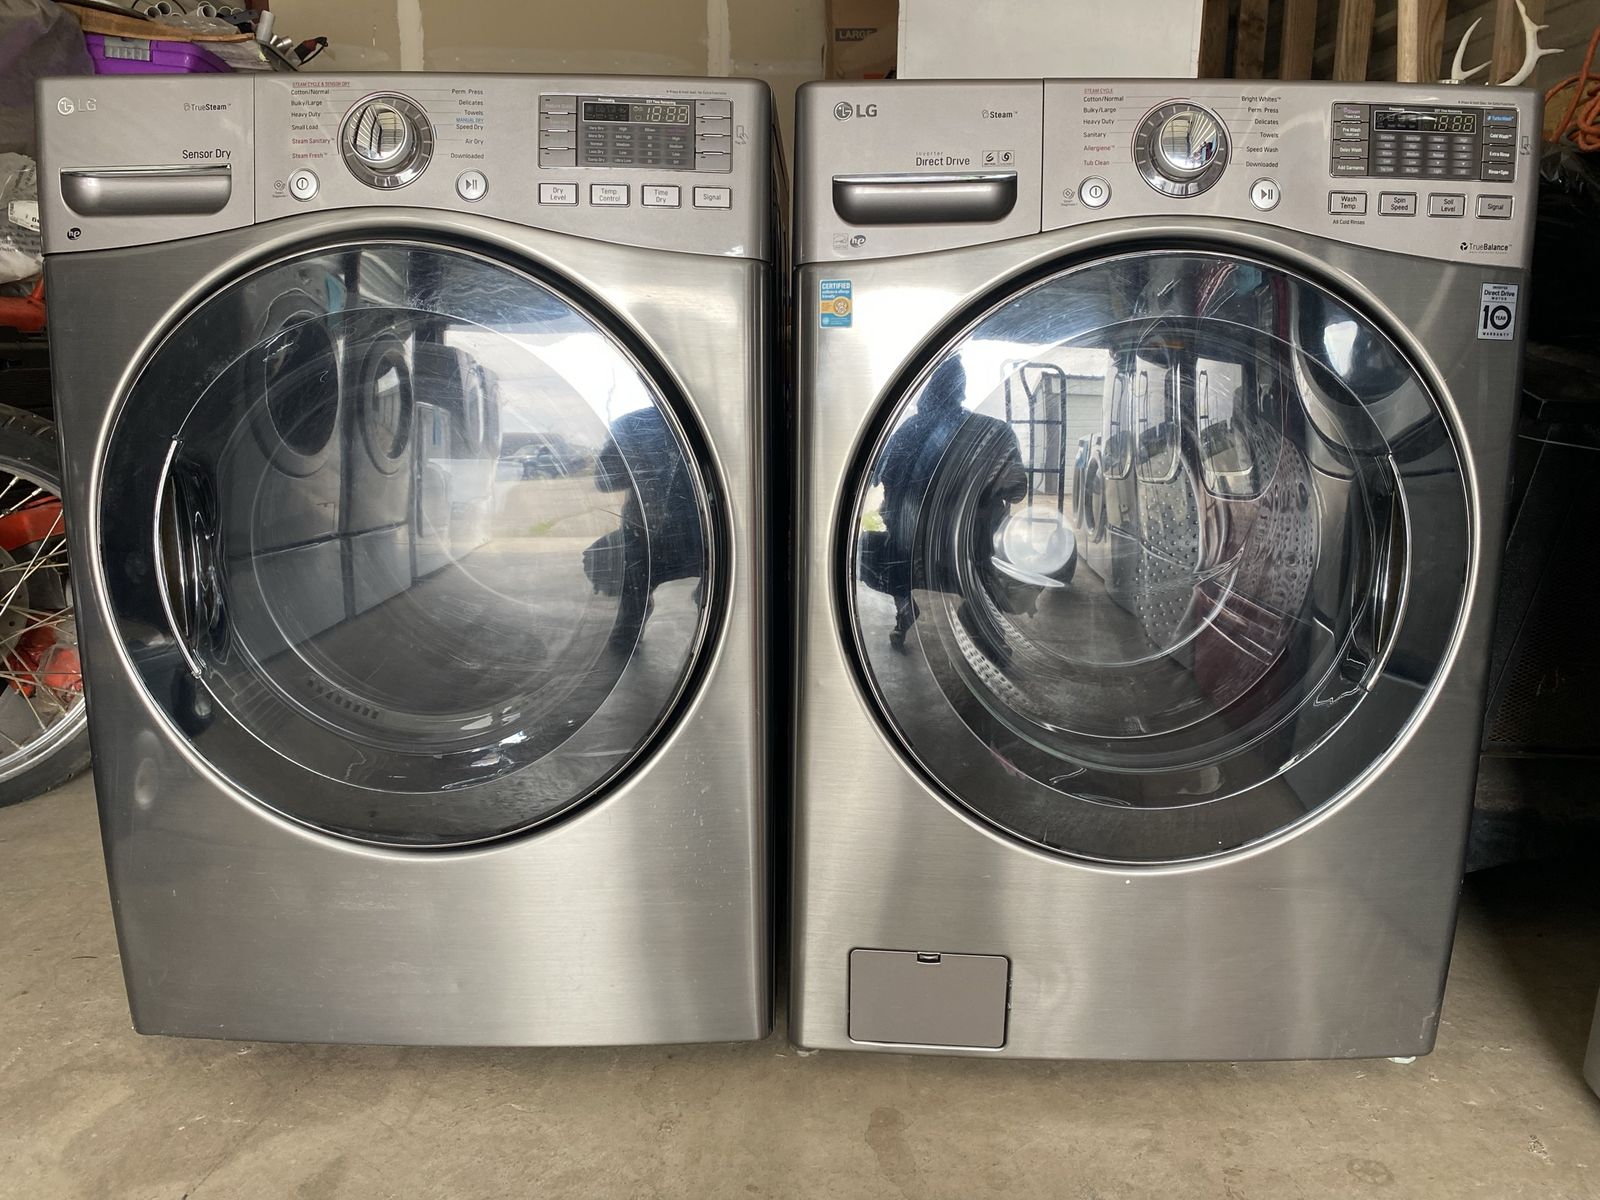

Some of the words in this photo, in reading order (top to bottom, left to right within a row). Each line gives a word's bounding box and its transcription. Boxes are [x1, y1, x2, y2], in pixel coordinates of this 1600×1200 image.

[290, 99, 323, 107] Bulky/Large
[1241, 95, 1259, 103] Bright
[77, 97, 98, 112] LG
[855, 103, 878, 118] LG
[1083, 106, 1117, 114] Bulky/Large
[989, 110, 1013, 119] Steam
[1254, 118, 1279, 126] Delicates
[1083, 131, 1106, 139] Sanitary
[474, 138, 484, 146] Dry
[182, 149, 213, 160] Sensor
[215, 148, 232, 160] Dry
[450, 152, 485, 160] Downloaded
[915, 157, 944, 166] Direct
[946, 156, 971, 166] Drive
[552, 187, 564, 195] Dry
[601, 187, 617, 196] Temp
[599, 194, 621, 202] Control
[655, 196, 667, 204] Dry
[703, 193, 721, 201] Signal
[1340, 202, 1356, 210] Temp
[1390, 203, 1409, 211] Speed
[1487, 203, 1505, 211] Signal
[1482, 304, 1512, 331] 10
